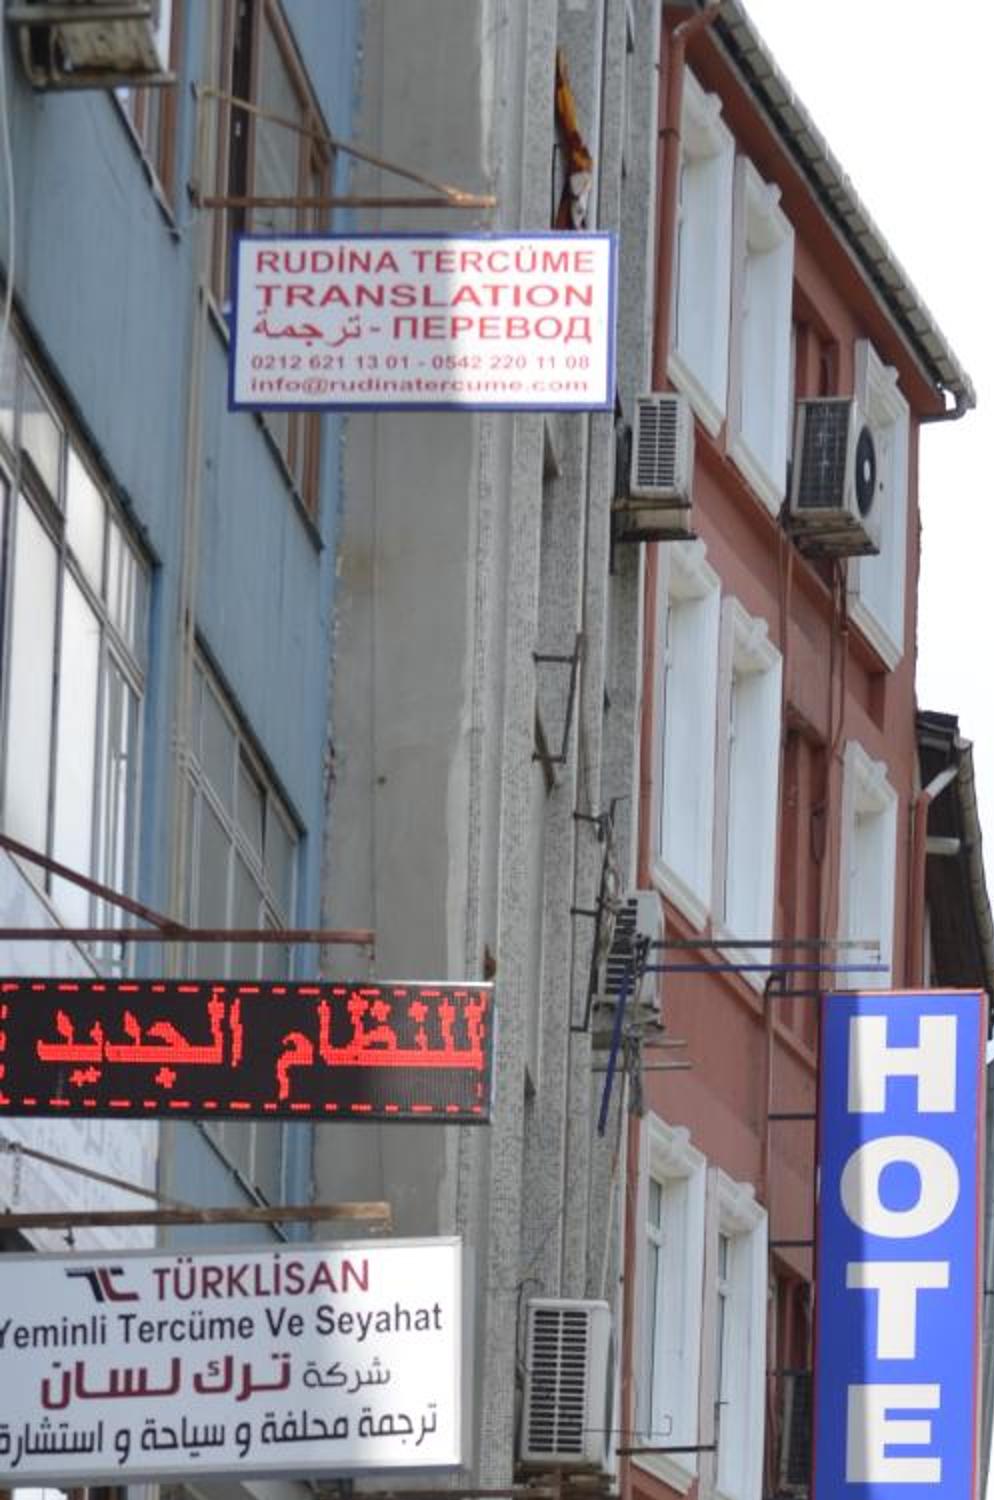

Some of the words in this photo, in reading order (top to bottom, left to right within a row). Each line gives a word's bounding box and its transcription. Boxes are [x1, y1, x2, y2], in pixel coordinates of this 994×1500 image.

[256, 246, 399, 273] RUDİNA
[412, 246, 596, 273] TERCÜME
[255, 284, 594, 308] TRANSLATION
[253, 309, 361, 347] ترجمة
[393, 316, 592, 344] ПЕРЕВОД
[251, 355, 301, 370] 0212
[309, 355, 344, 369] 621
[357, 355, 379, 369] 13
[386, 355, 408, 369] 01
[431, 355, 482, 370] 0542
[490, 355, 527, 370] 220
[536, 355, 556, 369] 11
[565, 355, 591, 369] 08
[250, 377, 589, 393] info@rudinatercume.com
[37, 992, 243, 1088] الجديد
[152, 1253, 370, 1301] TÜRKLİSAN
[117, 1310, 255, 1344] Tercüme
[265, 1306, 304, 1338] Ve
[315, 1301, 443, 1343] Seyahat
[41, 1357, 182, 1410] لسان
[302, 1356, 392, 1394] شركة
[140, 1416, 226, 1458] سياحة
[260, 1409, 349, 1441] محلفة
[357, 1402, 438, 1446] ترجمة
